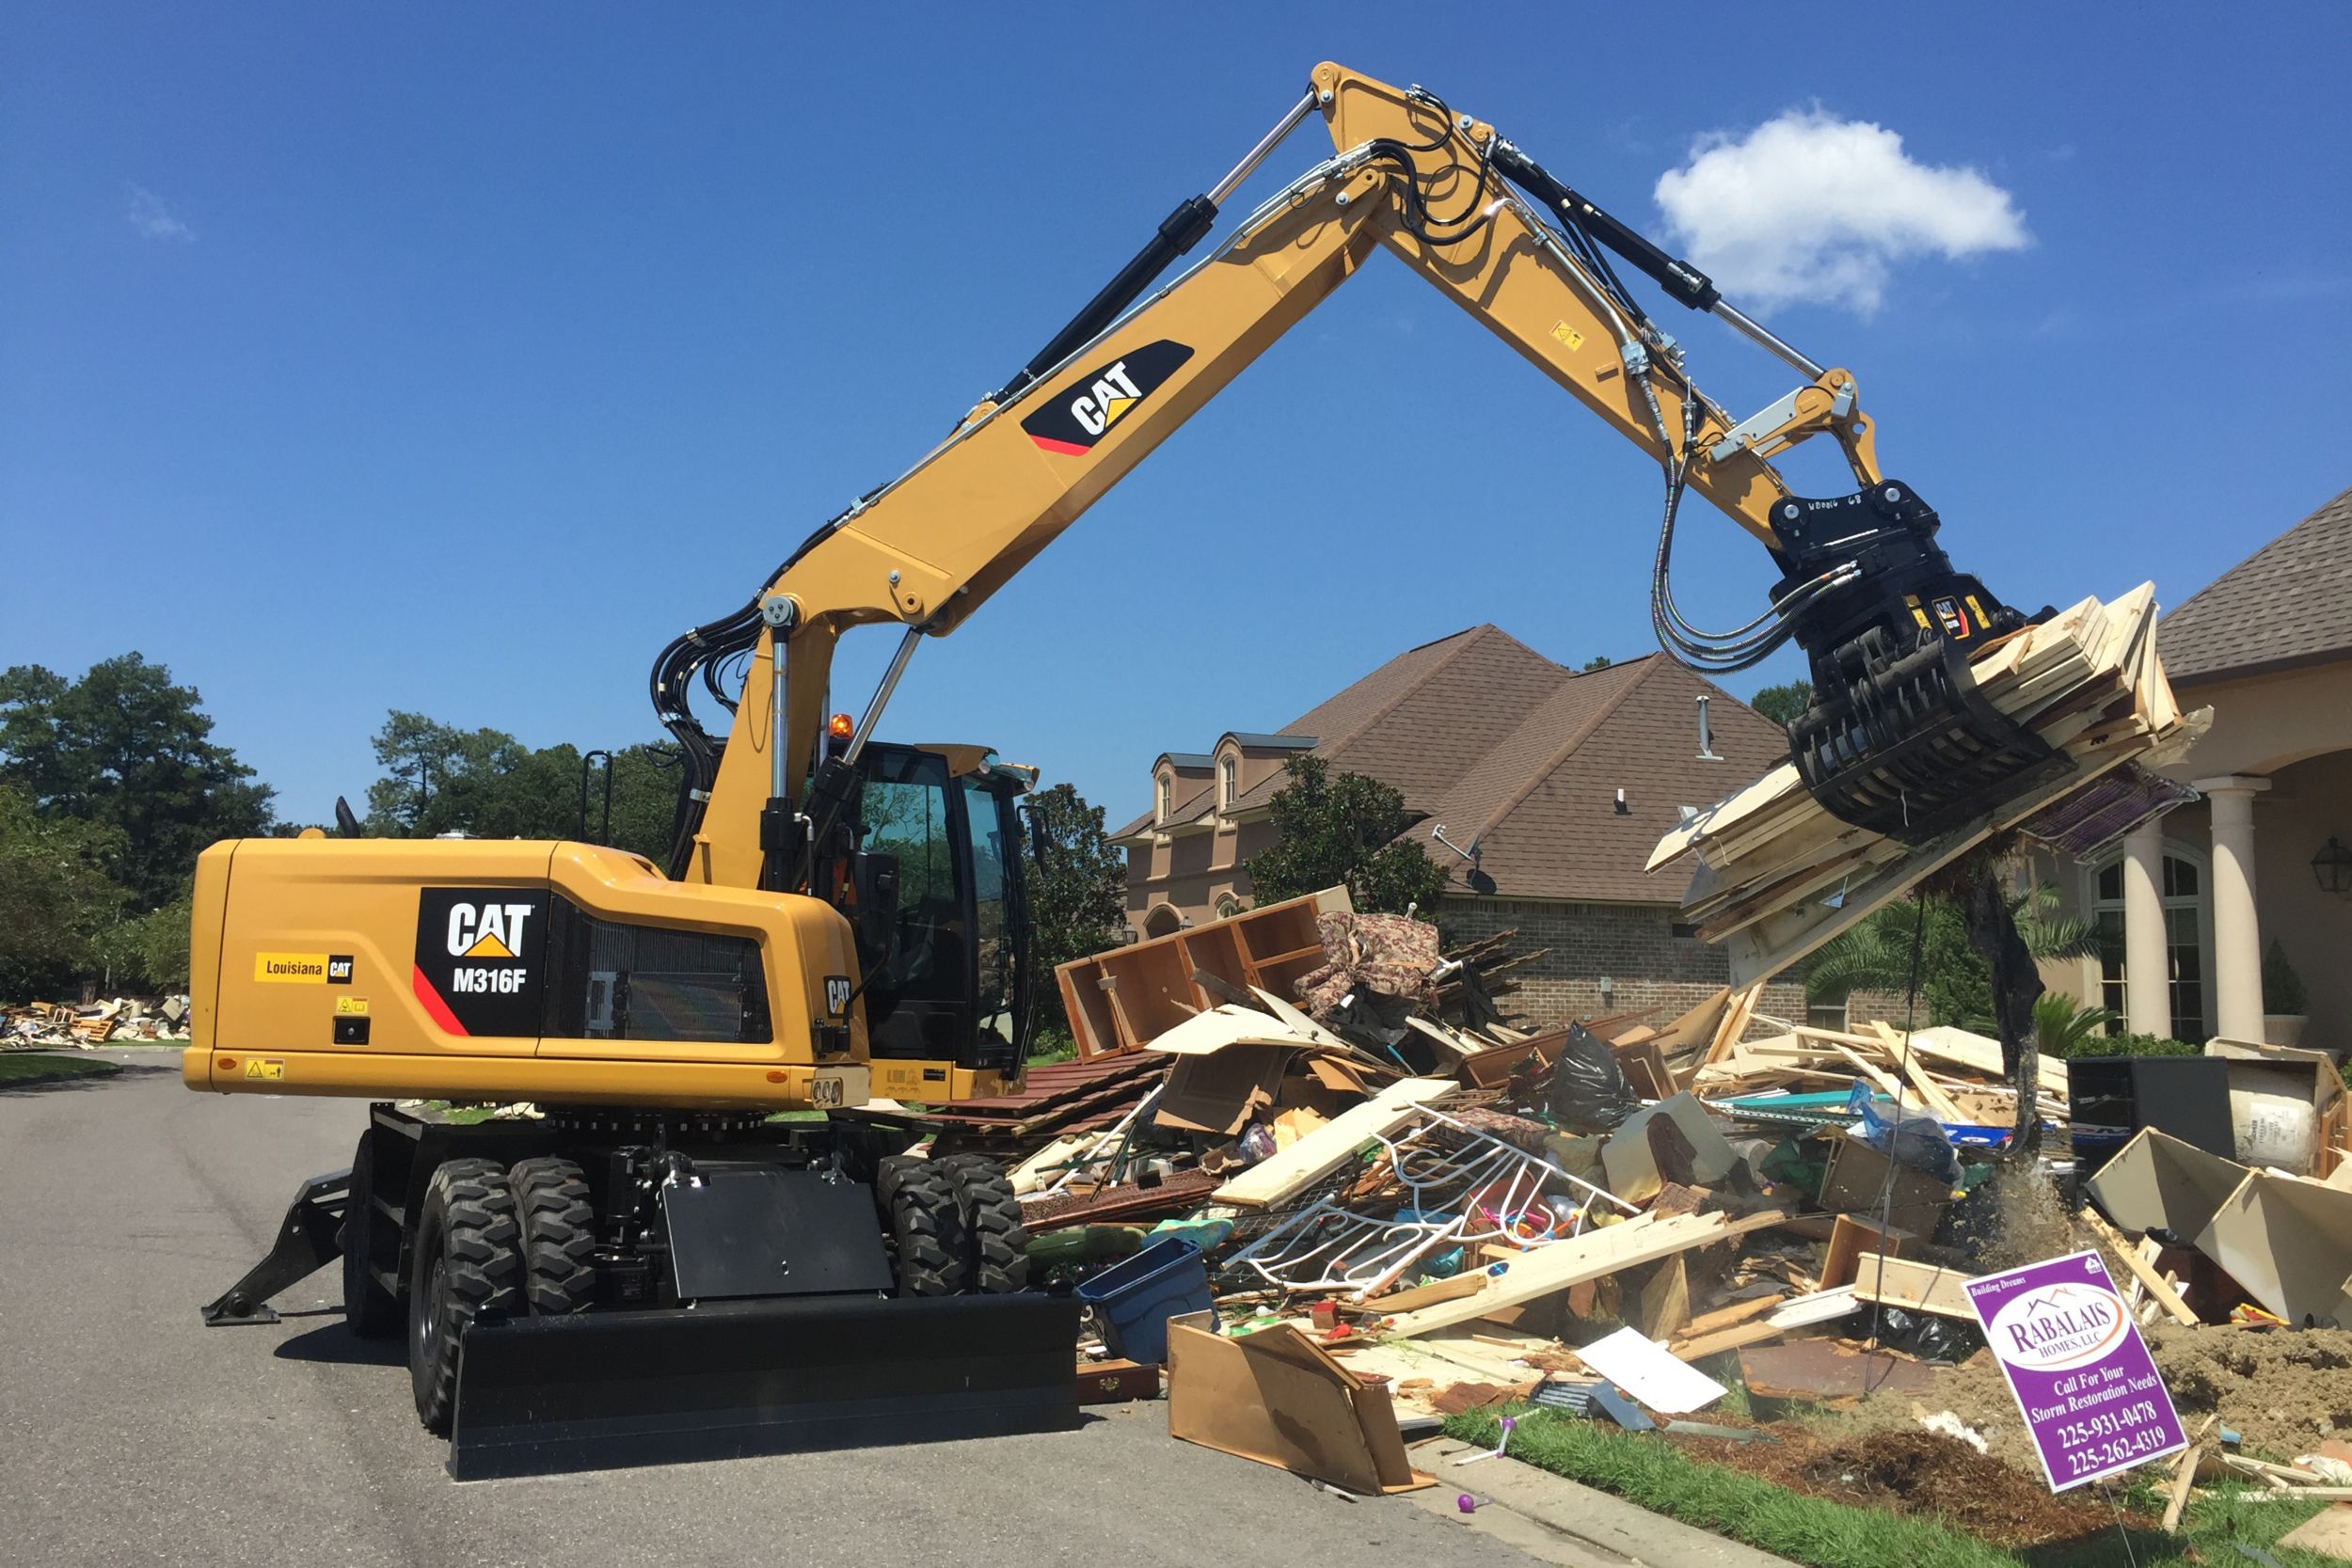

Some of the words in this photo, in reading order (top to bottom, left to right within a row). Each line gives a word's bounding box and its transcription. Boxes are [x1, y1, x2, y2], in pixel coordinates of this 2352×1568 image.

[1071, 360, 1143, 436] CAT
[1935, 600, 1957, 620] CAT
[447, 902, 532, 958] CAT
[266, 960, 323, 975] Louisiana
[329, 961, 352, 977] CAT
[453, 968, 527, 993] M316F
[828, 979, 850, 1014] CAT
[1970, 1283, 2001, 1297] Building
[2006, 1301, 2111, 1354] RABALAIS
[2038, 1338, 2081, 1358] HOMES,
[2079, 1331, 2103, 1350] LLC
[2031, 1402, 2067, 1424] Storm
[2068, 1384, 2128, 1413] Restoration
[2127, 1372, 2158, 1393] Needs
[2054, 1376, 2078, 1397] Call
[2079, 1373, 2099, 1389] For
[2099, 1366, 2124, 1383] Your
[2058, 1400, 2158, 1449] 225-931-0478
[2068, 1425, 2167, 1476] 225-262-4319
